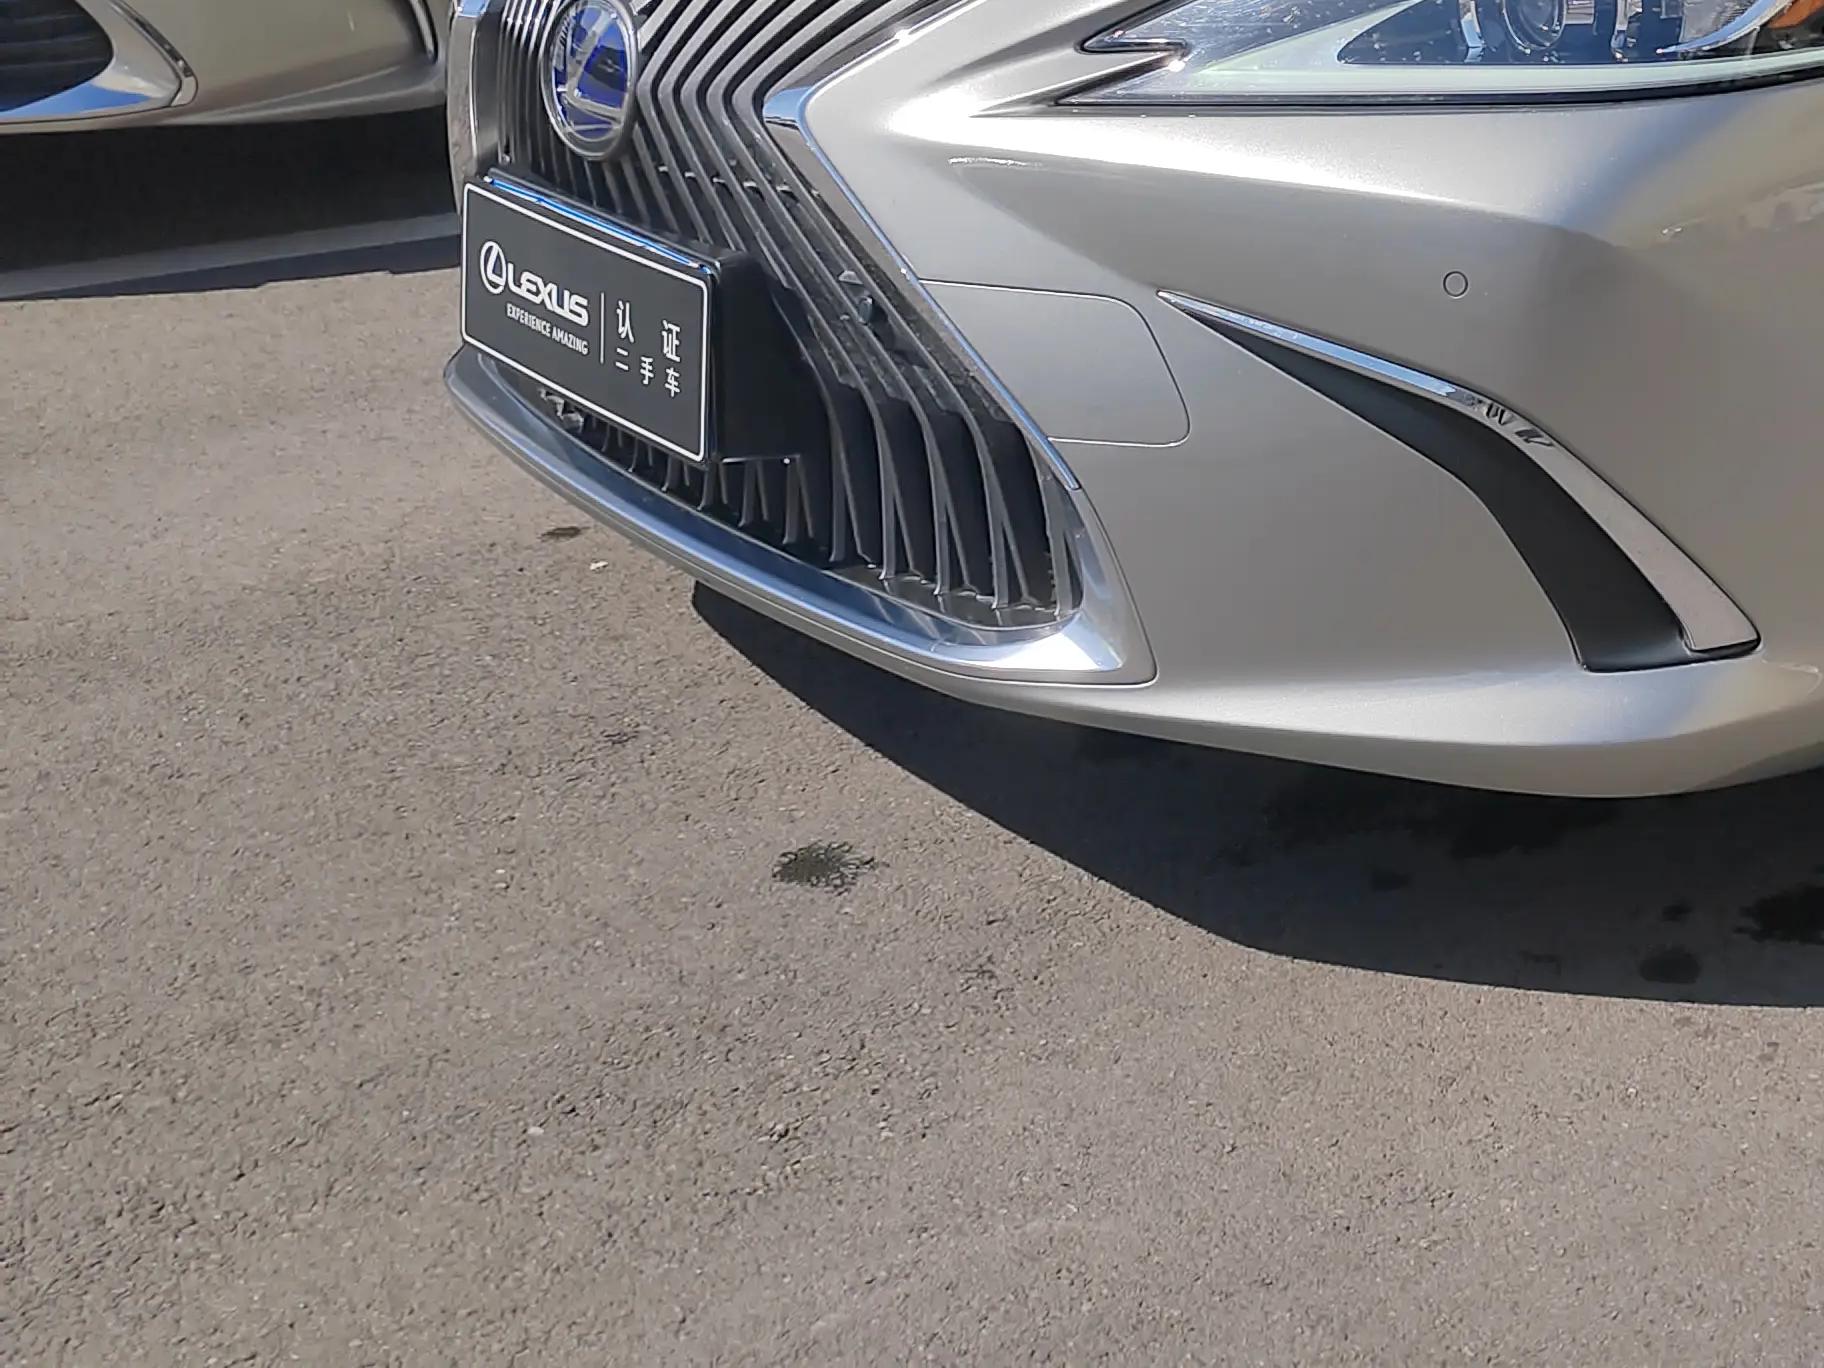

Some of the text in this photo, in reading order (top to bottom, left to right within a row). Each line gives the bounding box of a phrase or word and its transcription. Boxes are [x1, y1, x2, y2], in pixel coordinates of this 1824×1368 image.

[508, 262, 589, 326] LEXUS
[506, 302, 589, 356] EXPERIENCE AMAZING
